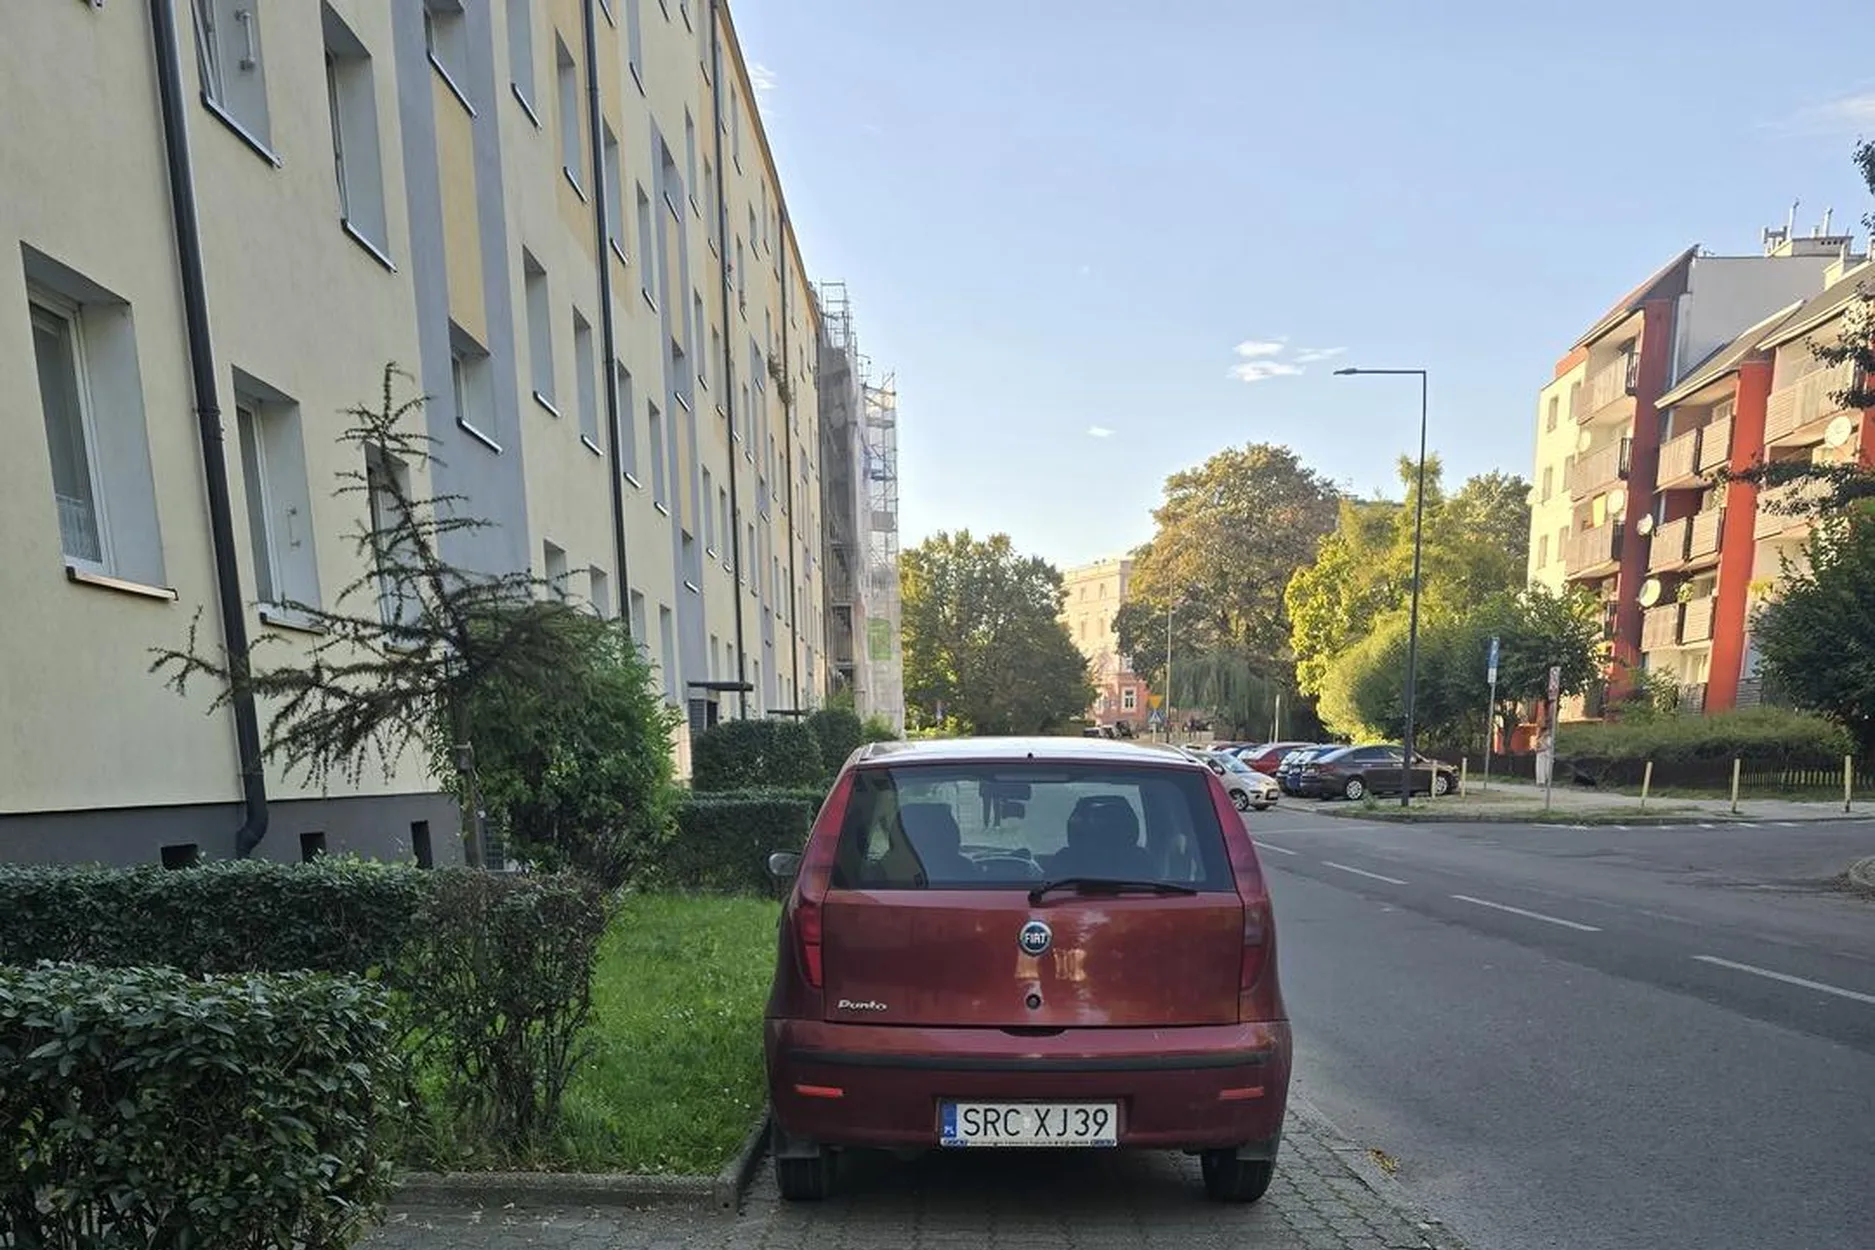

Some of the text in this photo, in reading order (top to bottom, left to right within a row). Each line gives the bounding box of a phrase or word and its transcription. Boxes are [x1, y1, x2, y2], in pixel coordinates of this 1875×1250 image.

[1025, 933, 1046, 944] FIAT
[838, 999, 887, 1011] Punto
[963, 1108, 1109, 1137] SRC XJ39
